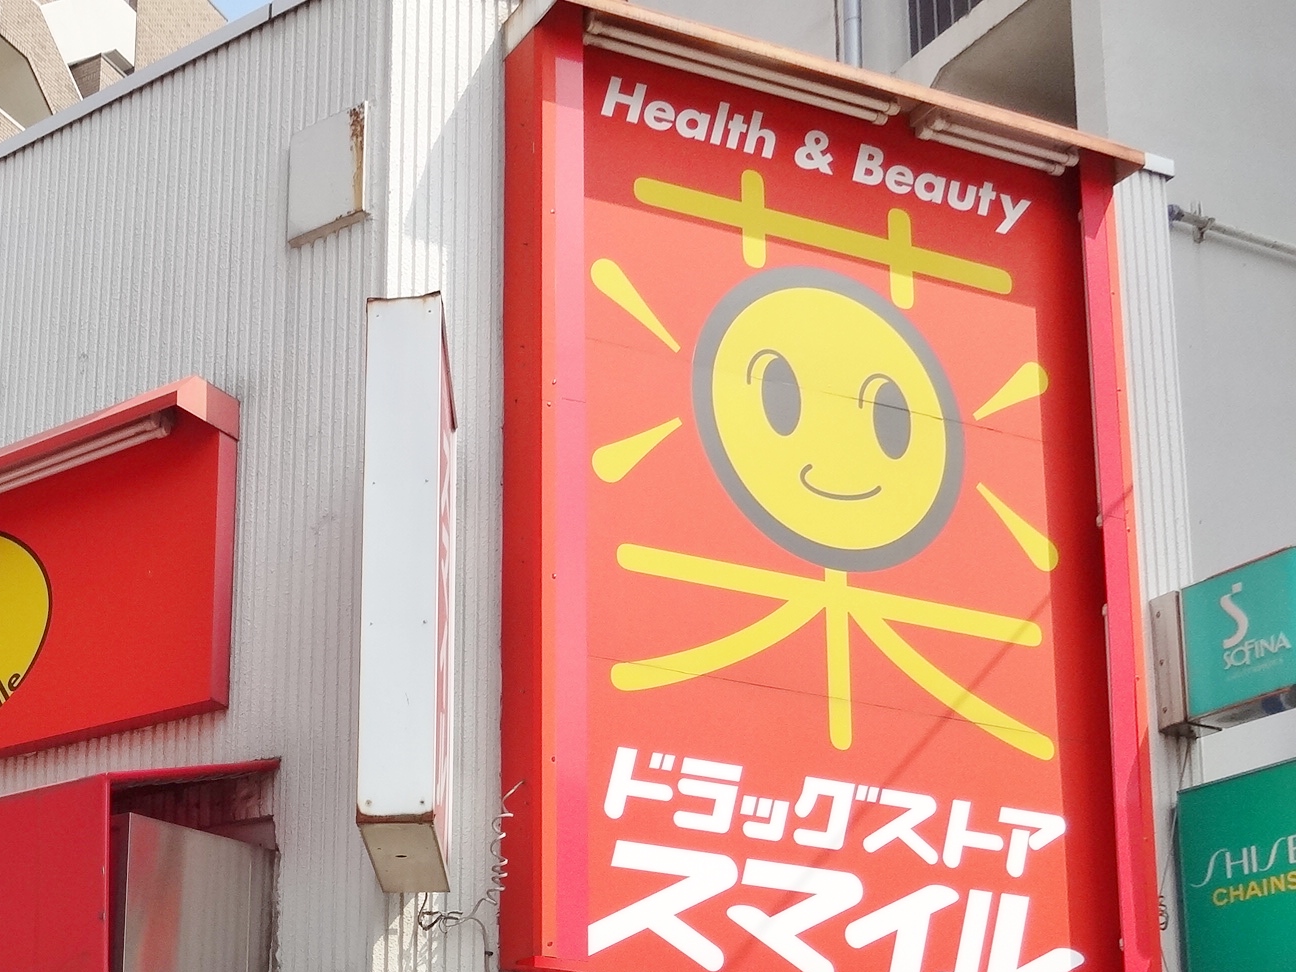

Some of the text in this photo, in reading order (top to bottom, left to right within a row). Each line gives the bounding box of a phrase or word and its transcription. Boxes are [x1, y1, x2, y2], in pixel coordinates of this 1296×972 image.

[600, 76, 1032, 236] Health & Beauty
[1223, 632, 1292, 670] SOFINA
[604, 745, 1067, 879] ドラッグストア
